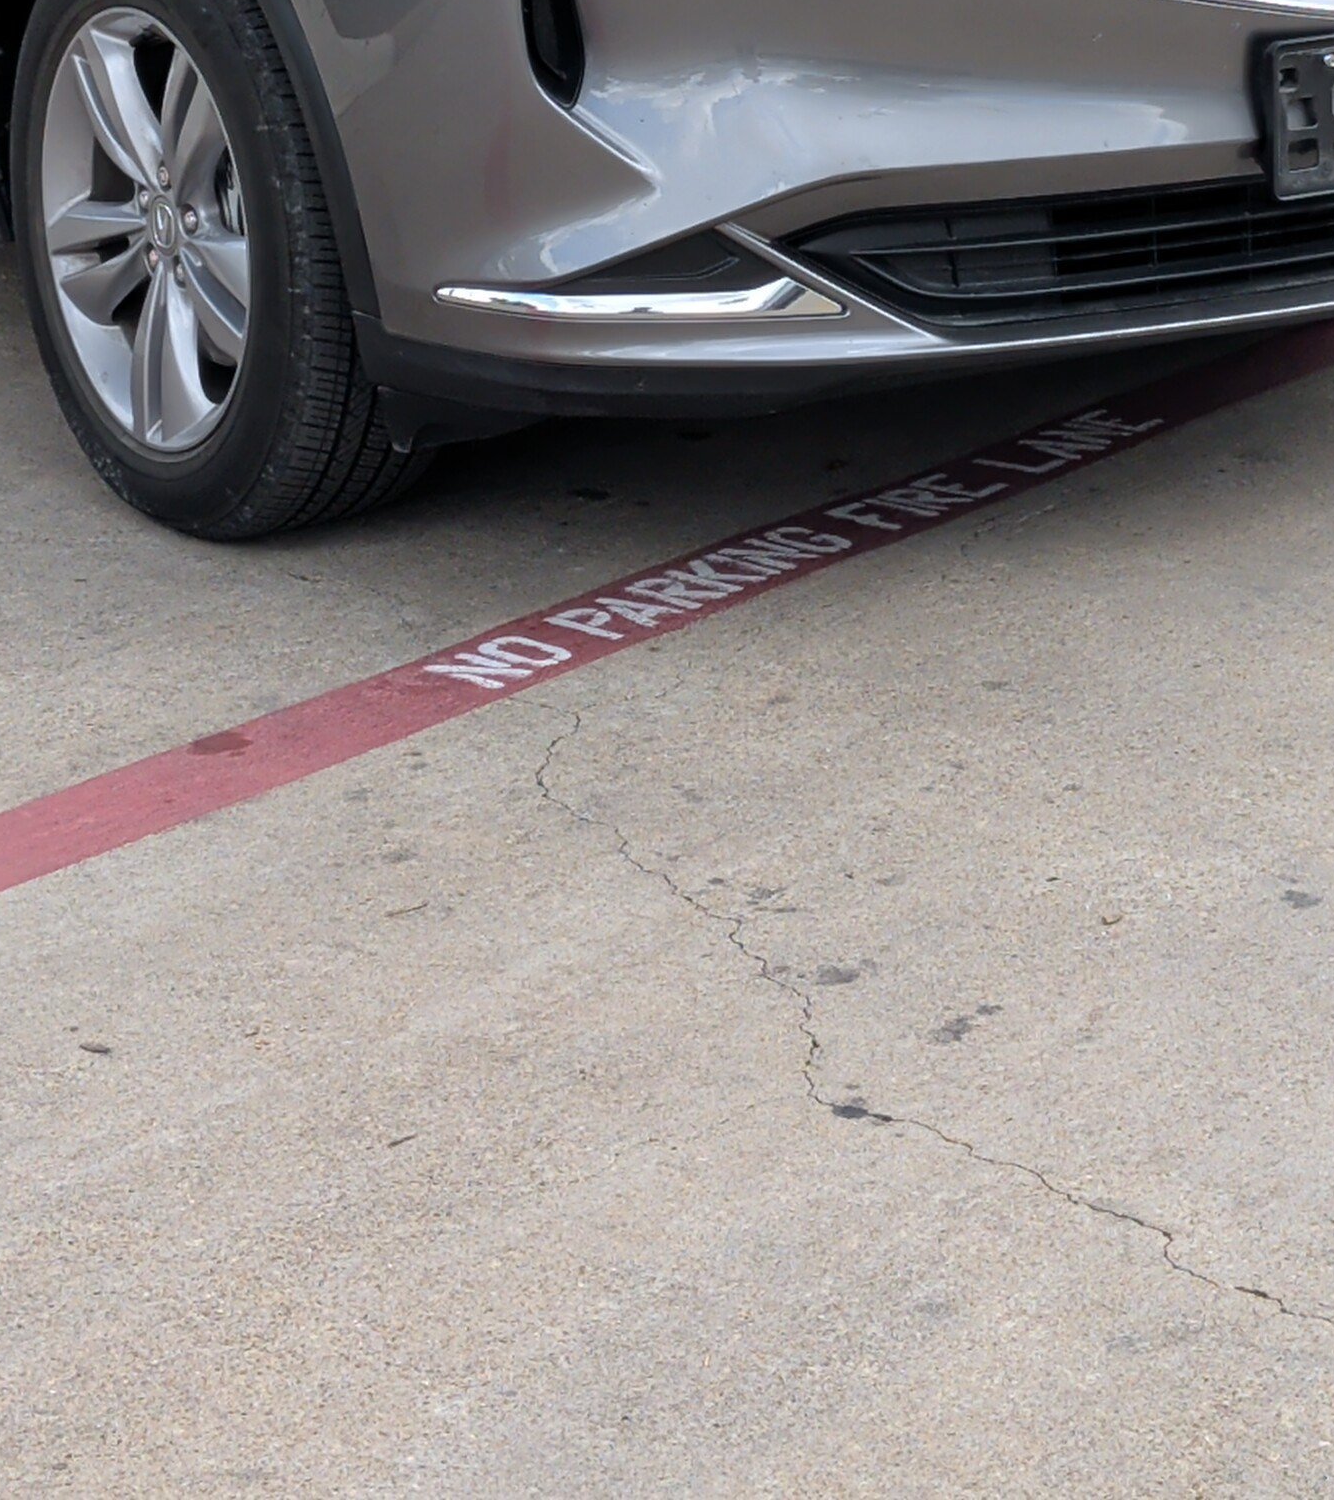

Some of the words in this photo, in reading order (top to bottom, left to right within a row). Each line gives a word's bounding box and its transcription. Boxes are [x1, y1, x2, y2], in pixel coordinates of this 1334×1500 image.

[424, 634, 573, 689] NO
[545, 525, 853, 642] PARKING
[824, 472, 1010, 532] FIRE
[974, 408, 1166, 476] LANE
